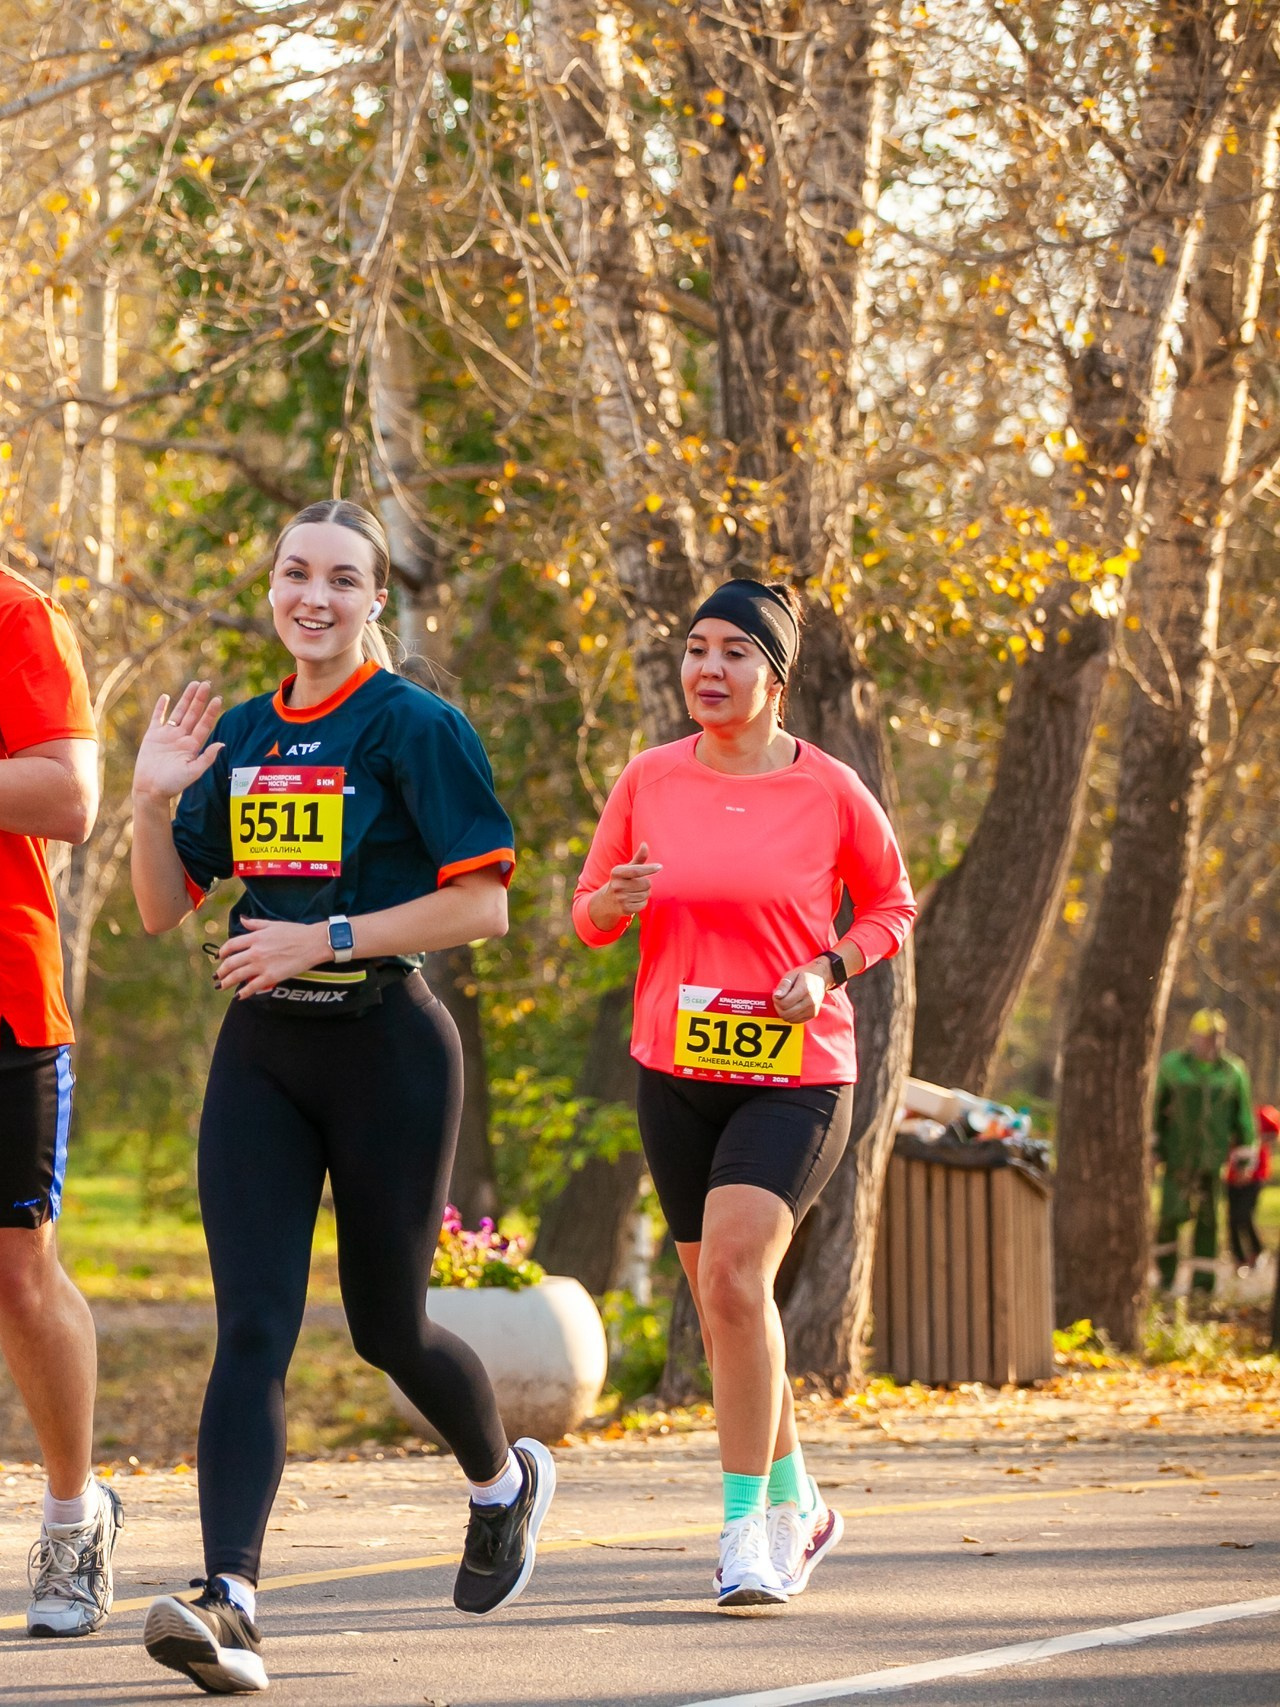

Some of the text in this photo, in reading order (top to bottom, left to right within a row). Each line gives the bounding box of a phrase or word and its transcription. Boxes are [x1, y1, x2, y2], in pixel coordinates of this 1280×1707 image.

[239, 801, 324, 843] 5511
[270, 846, 302, 854] ГАЛИНА
[271, 986, 349, 1003] DEMIX
[686, 1016, 793, 1059] 5187
[698, 1055, 774, 1069] ГАНЕЕВА НАДЕЖДА
